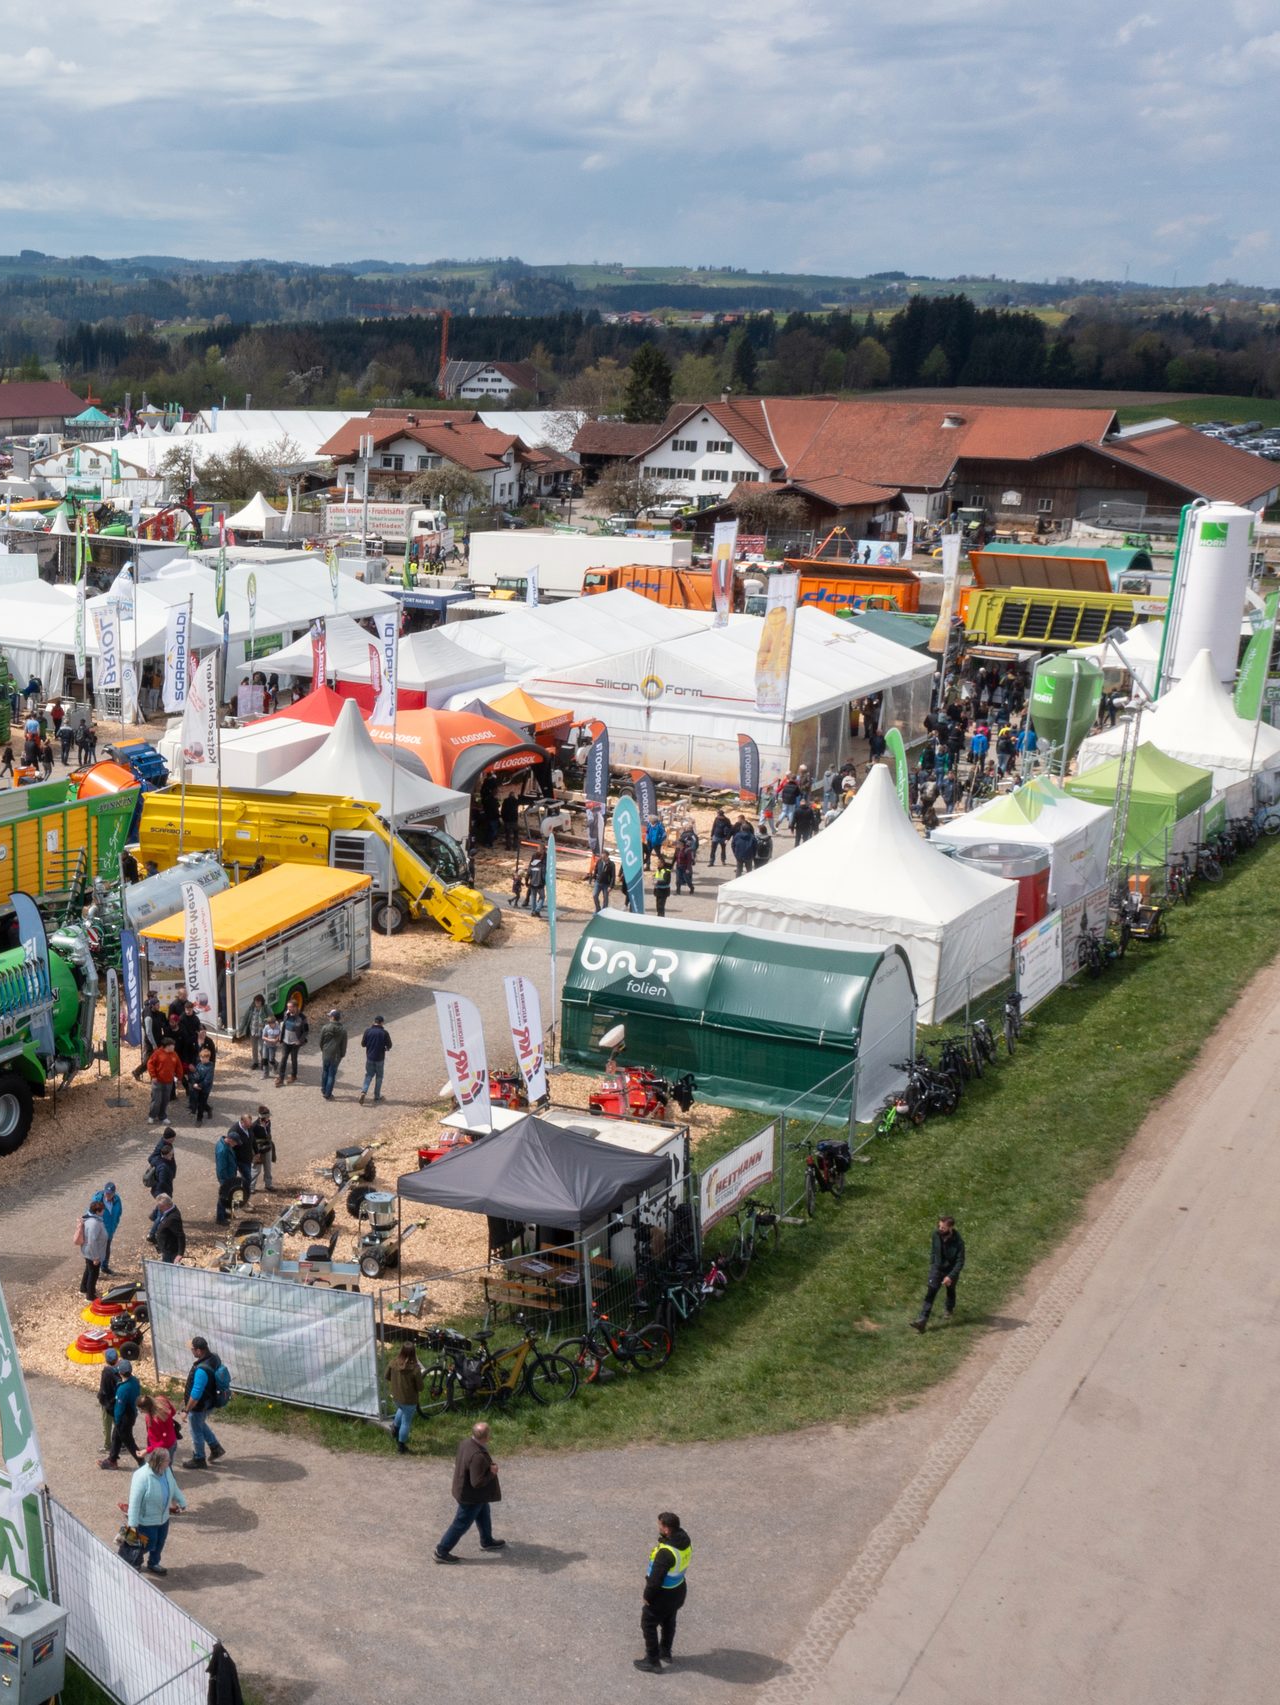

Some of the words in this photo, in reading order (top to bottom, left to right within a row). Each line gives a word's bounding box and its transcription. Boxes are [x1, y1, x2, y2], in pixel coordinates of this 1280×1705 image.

[1200, 539, 1227, 548] HORN
[174, 612, 188, 701] SGARIBOLDI
[595, 678, 640, 692] Silicon
[665, 684, 703, 698] Form
[1033, 692, 1053, 704] HORN
[377, 728, 423, 745] LOGOSOL
[459, 730, 497, 745] LOGOSOL
[501, 754, 537, 770] LOGOSOL
[626, 979, 668, 998] folien
